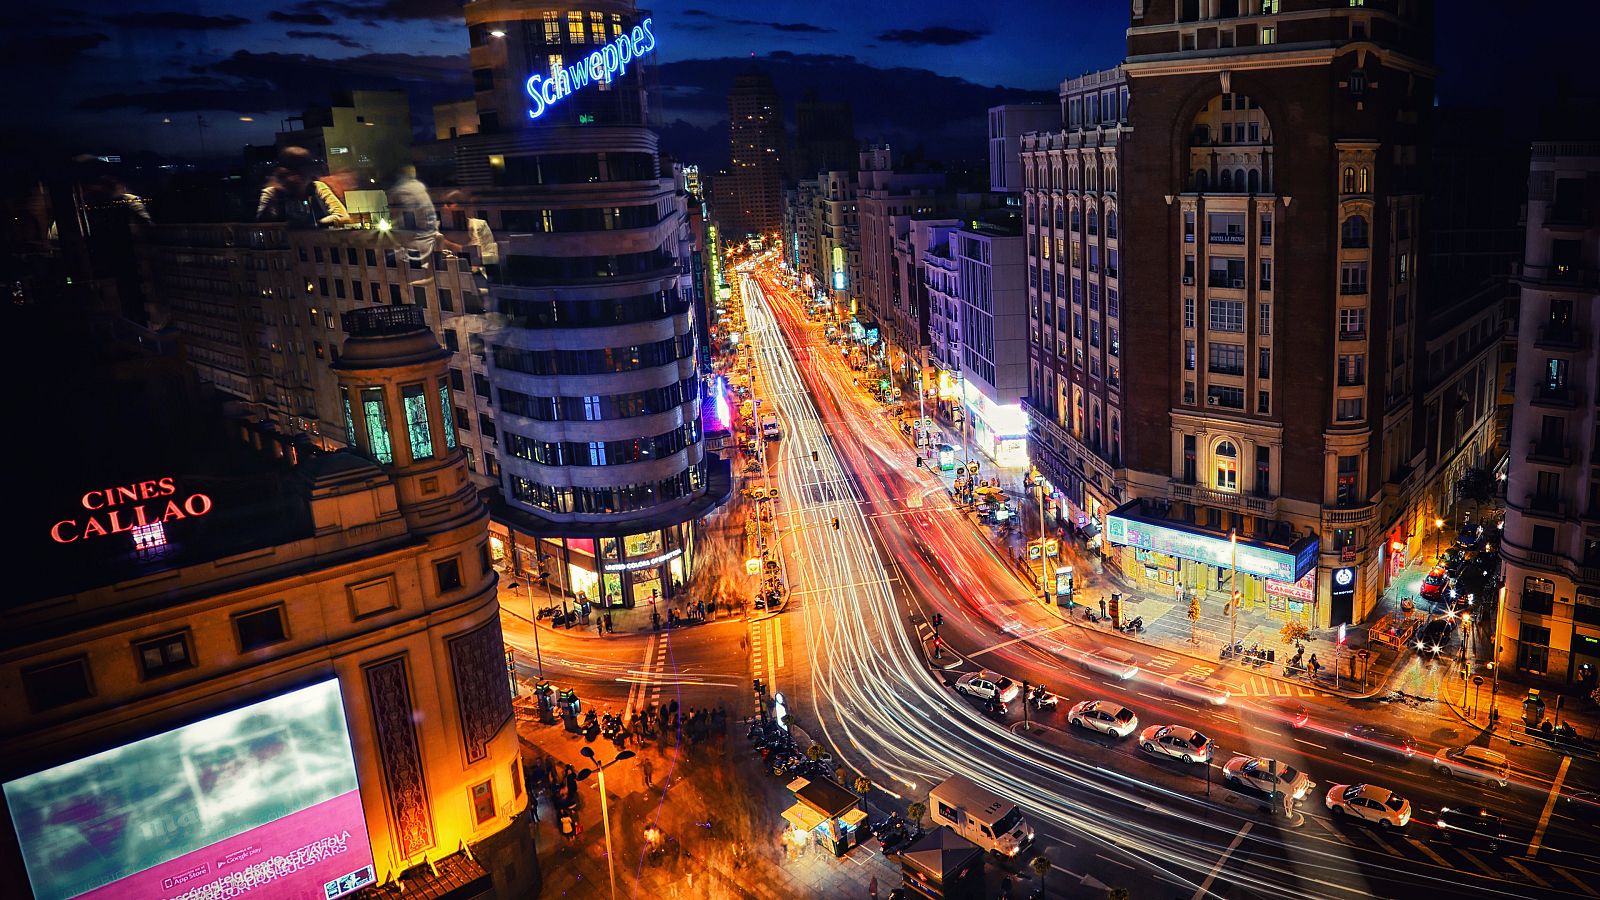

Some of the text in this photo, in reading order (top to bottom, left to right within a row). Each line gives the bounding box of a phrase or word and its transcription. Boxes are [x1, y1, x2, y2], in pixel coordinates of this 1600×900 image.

[527, 17, 655, 118] Schweppes
[702, 345, 711, 370] REX
[82, 477, 176, 510] CINES
[51, 493, 212, 544] CALLAO
[174, 876, 189, 885] App
[188, 869, 207, 880] Store
